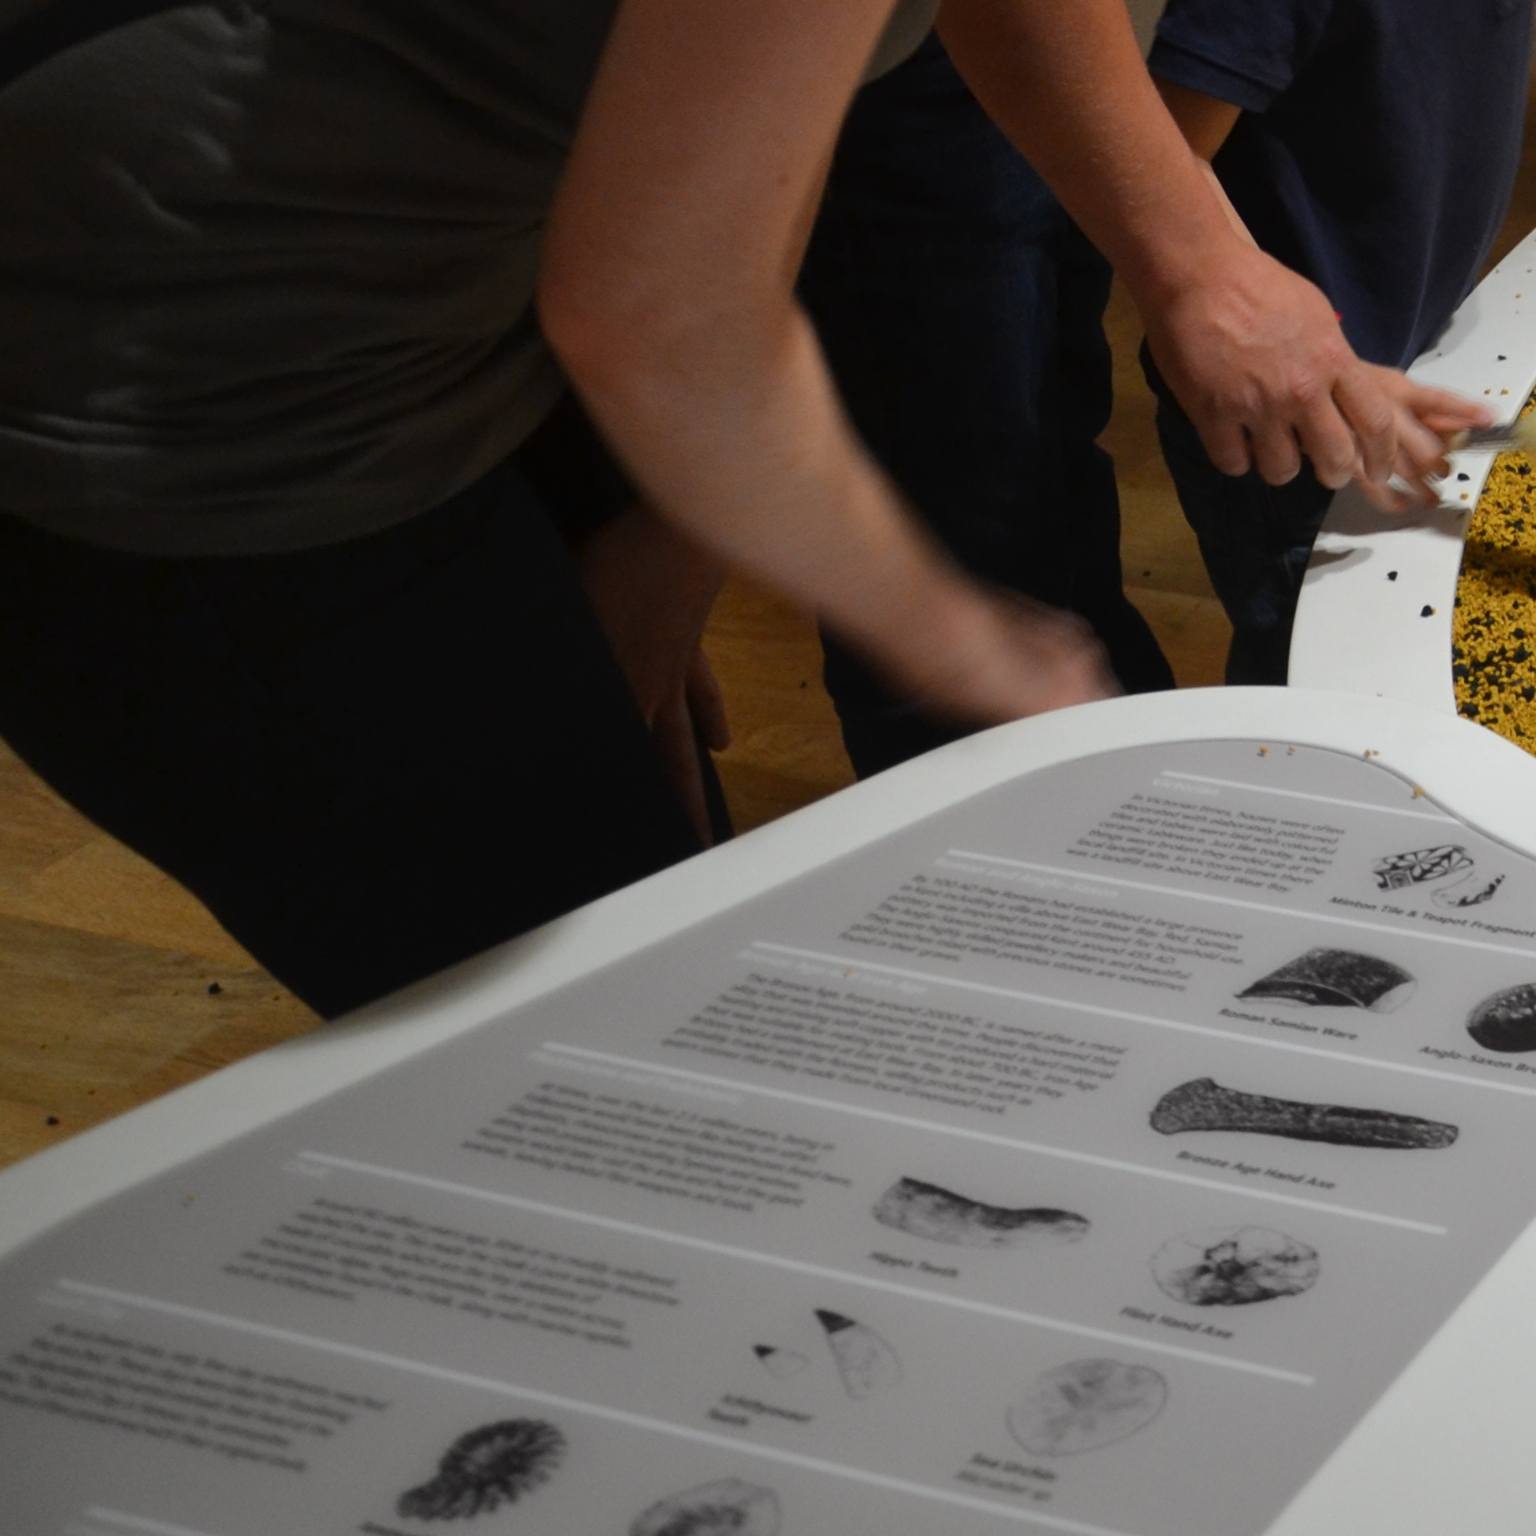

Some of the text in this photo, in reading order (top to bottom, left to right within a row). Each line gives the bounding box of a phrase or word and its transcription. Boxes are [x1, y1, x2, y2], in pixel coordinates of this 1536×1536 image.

[1329, 896, 1377, 911] Minton
[1381, 905, 1404, 915] Tile
[1422, 911, 1467, 927] Teapot
[1470, 921, 1536, 938] Fragment
[1218, 1009, 1357, 1041] Roman Samian Ware
[1419, 1045, 1512, 1069] Anglo-Saxon
[1176, 1150, 1336, 1189] Bronze Age Hand Axe
